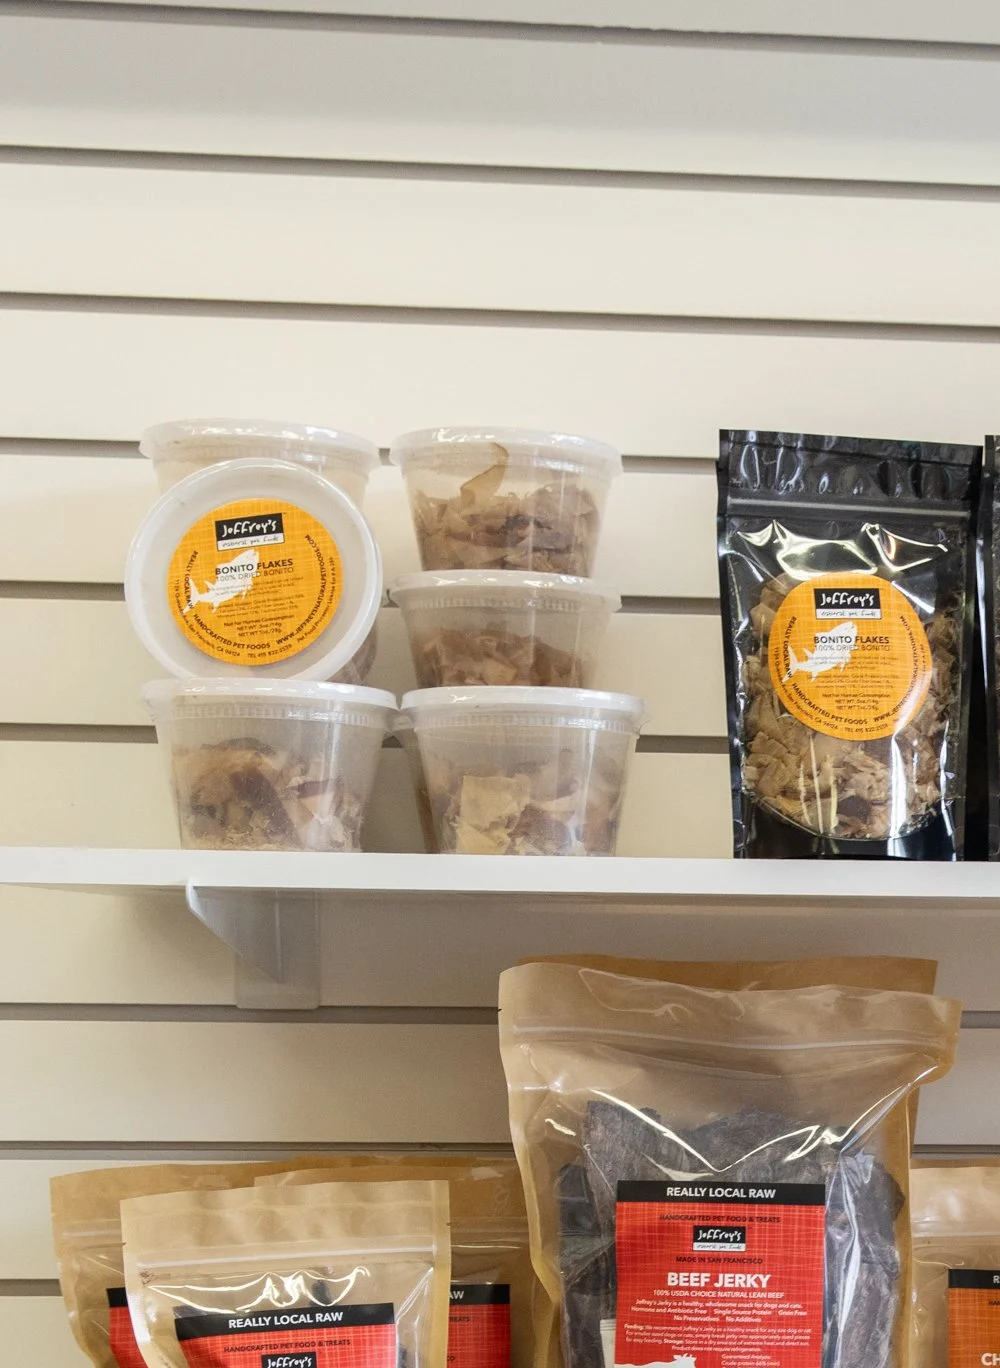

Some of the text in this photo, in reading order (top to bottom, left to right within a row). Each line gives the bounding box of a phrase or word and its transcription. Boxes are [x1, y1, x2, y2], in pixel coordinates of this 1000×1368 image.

[222, 520, 276, 538] Jeffrey's
[215, 558, 294, 575] BONITO FLAKES
[263, 567, 294, 576] BONITO
[821, 593, 874, 607] Jeffrey's
[193, 614, 232, 646] HANDCRAFTED
[246, 642, 270, 650] FOODS
[667, 1188, 776, 1198] REALLY LOCAL RAW
[697, 1230, 741, 1242] Jeffrey's
[668, 1273, 771, 1288] BEEF JERKY
[229, 1312, 343, 1329] REALLY LOCAL RAW
[224, 1344, 279, 1352] HANDCRAFTED
